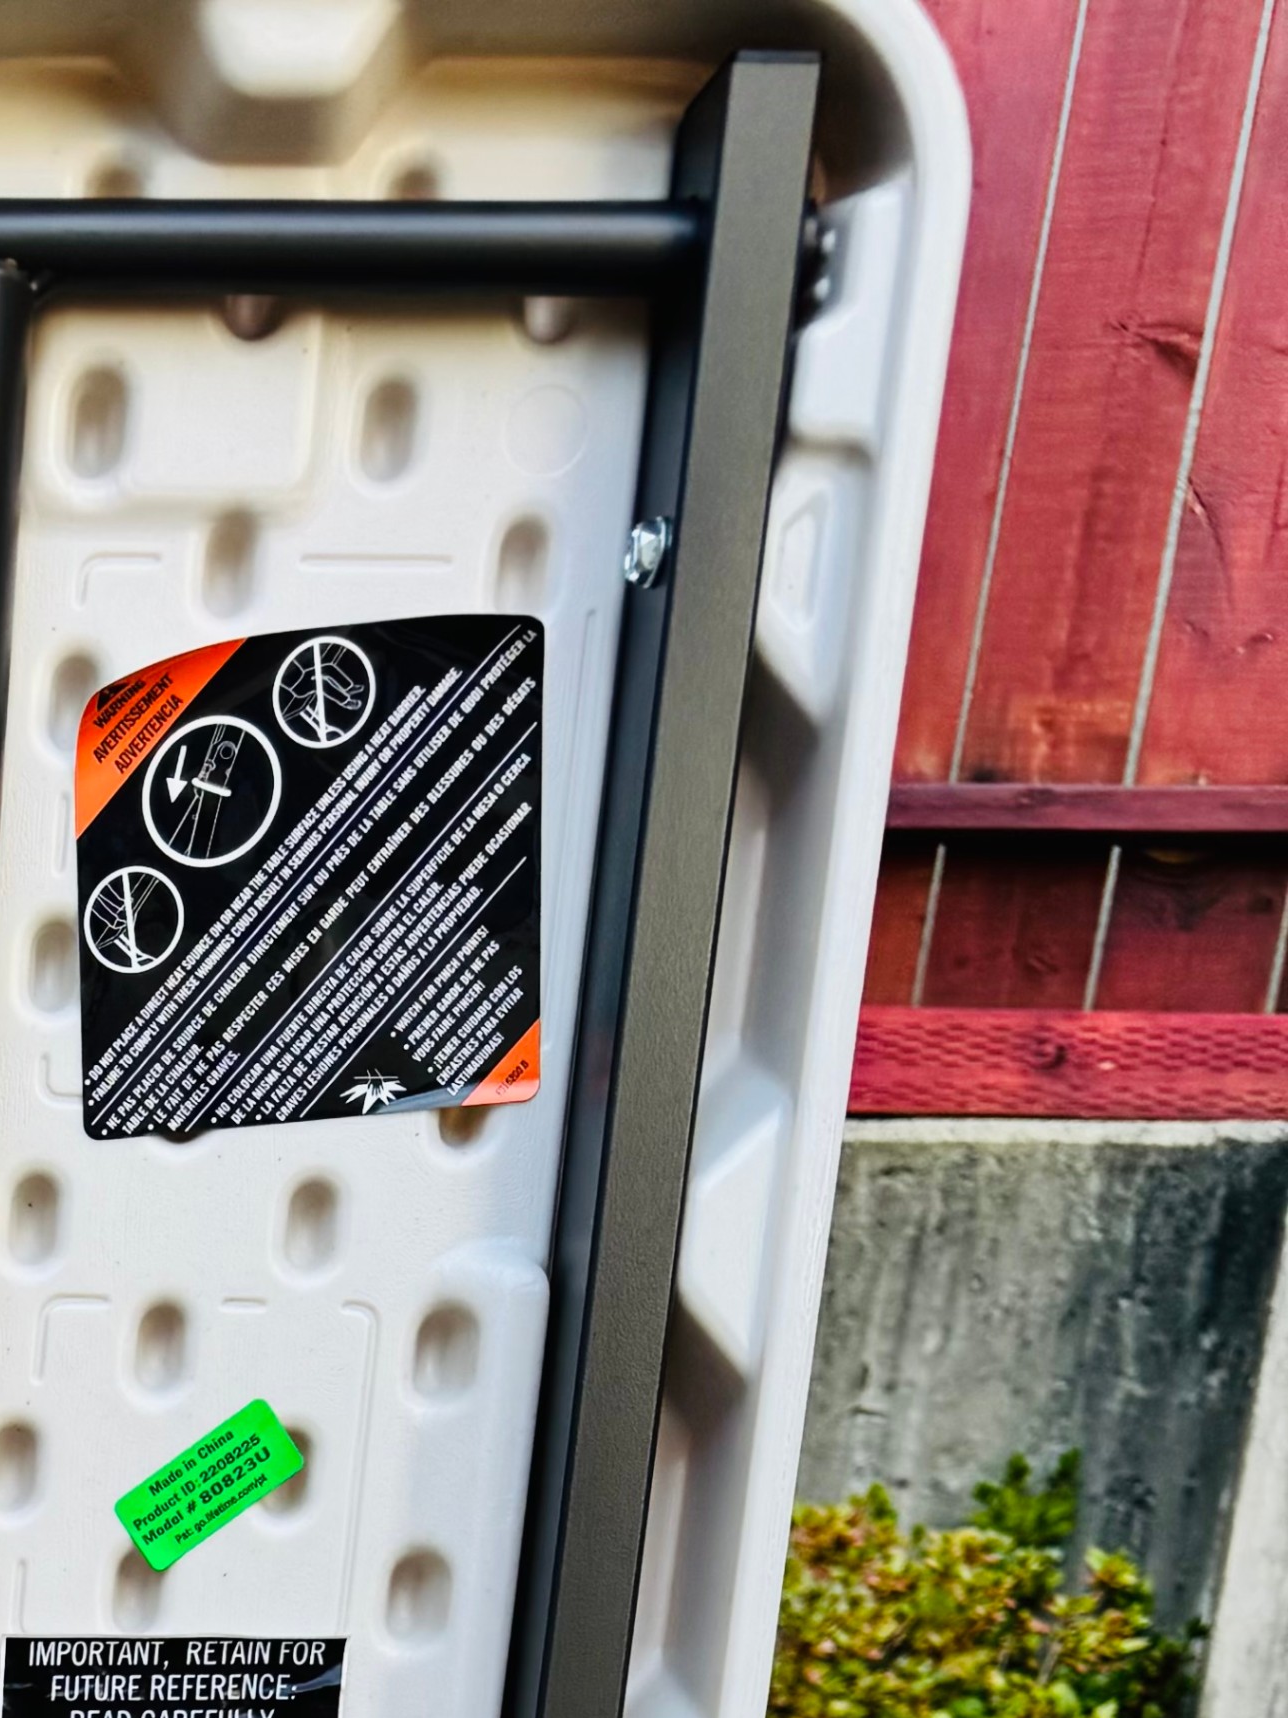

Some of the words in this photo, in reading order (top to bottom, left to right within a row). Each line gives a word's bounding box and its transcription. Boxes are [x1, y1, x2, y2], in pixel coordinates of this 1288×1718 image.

[93, 679, 146, 729] WARNING
[93, 672, 174, 764] AVERTISSEMENT
[387, 685, 426, 726] BARRIER.
[114, 694, 184, 774] ADVERTENCIA
[364, 743, 375, 755] A
[369, 721, 392, 747] HEAT
[341, 750, 368, 780] USING
[315, 776, 346, 811] UNLESS
[283, 807, 320, 849] SURFACE
[262, 844, 289, 873] TABLE
[91, 1064, 123, 1101] FAILURE
[118, 1053, 133, 1068] TO
[128, 1021, 159, 1057] COMPLY
[155, 1000, 178, 1024] WITH
[173, 974, 199, 1004] THESE
[194, 933, 235, 978] WARNINGS
[230, 906, 258, 937] COULD
[253, 875, 283, 910] RESULT
[279, 865, 292, 880] IN
[287, 830, 322, 869] SERIOUS
[317, 789, 358, 834] PERSONAL
[353, 758, 381, 792] INJURY
[377, 746, 394, 763] OR
[388, 701, 430, 750] PROPERTY
[425, 666, 462, 707] DAMAGE.
[248, 869, 268, 890] THE
[230, 886, 254, 912] NEAR
[152, 1108, 167, 1123] LE
[163, 1087, 184, 1110] FAIT
[181, 1073, 196, 1090] DE
[193, 1059, 208, 1075] NE
[205, 1040, 225, 1061] PAS
[222, 990, 268, 1042] RESPECTER
[265, 970, 285, 992] CES
[306, 926, 322, 944] EN
[319, 895, 348, 929] GARDE
[345, 870, 369, 899] PEUT
[409, 801, 429, 823] DES
[426, 748, 474, 804] BLESSURES
[470, 732, 487, 751] OU
[483, 712, 504, 736] DES
[208, 921, 224, 938] ON
[219, 908, 235, 925] OR
[214, 1101, 230, 1117] NO
[226, 1062, 264, 1104] COLOCAR
[260, 1044, 280, 1065] UNA
[275, 1011, 308, 1048] FUENTE
[303, 976, 339, 1015] DIRECTA
[334, 962, 350, 979] DE
[345, 934, 374, 966] CALOR
[370, 904, 400, 937] SOBRE
[395, 893, 410, 908] LA
[405, 840, 455, 896] SUPERFICIE
[450, 827, 466, 845] DE
[461, 816, 476, 832] LA
[471, 791, 498, 820] MESA
[493, 782, 504, 794] O
[500, 753, 531, 786] CERCA
[181, 933, 214, 970] SOURCE
[164, 965, 186, 990] HEAT
[139, 985, 168, 1019] DIRECT
[230, 1108, 246, 1124] DE
[241, 1097, 256, 1111] LA
[251, 1068, 281, 1100] MISMA
[276, 1052, 294, 1071] SIN
[289, 1029, 314, 1055] USAR
[309, 1011, 330, 1032] UNA
[372, 922, 407, 959] CONTRA
[401, 911, 417, 925] EL
[412, 881, 444, 913] CALOR.
[112, 1021, 138, 1051] PLACE
[134, 1016, 145, 1026] A
[88, 1064, 103, 1080] DO
[98, 1047, 116, 1068] NOT
[206, 1050, 240, 1085] GRAVES.
[148, 1468, 183, 1496] Made
[181, 1458, 197, 1471] in
[197, 1430, 234, 1459] China
[132, 1492, 181, 1531] Product
[141, 1510, 183, 1545] Model
[186, 1499, 196, 1514] #
[198, 1446, 270, 1504] 80823U
[174, 1528, 194, 1544] Pat:
[29, 1641, 169, 1669] IMPORTANT,
[186, 1641, 271, 1666] RETAIN
[279, 1642, 326, 1665] FOR
[51, 1675, 141, 1701] FUTURE
[150, 1674, 296, 1700] REFERENCE:
